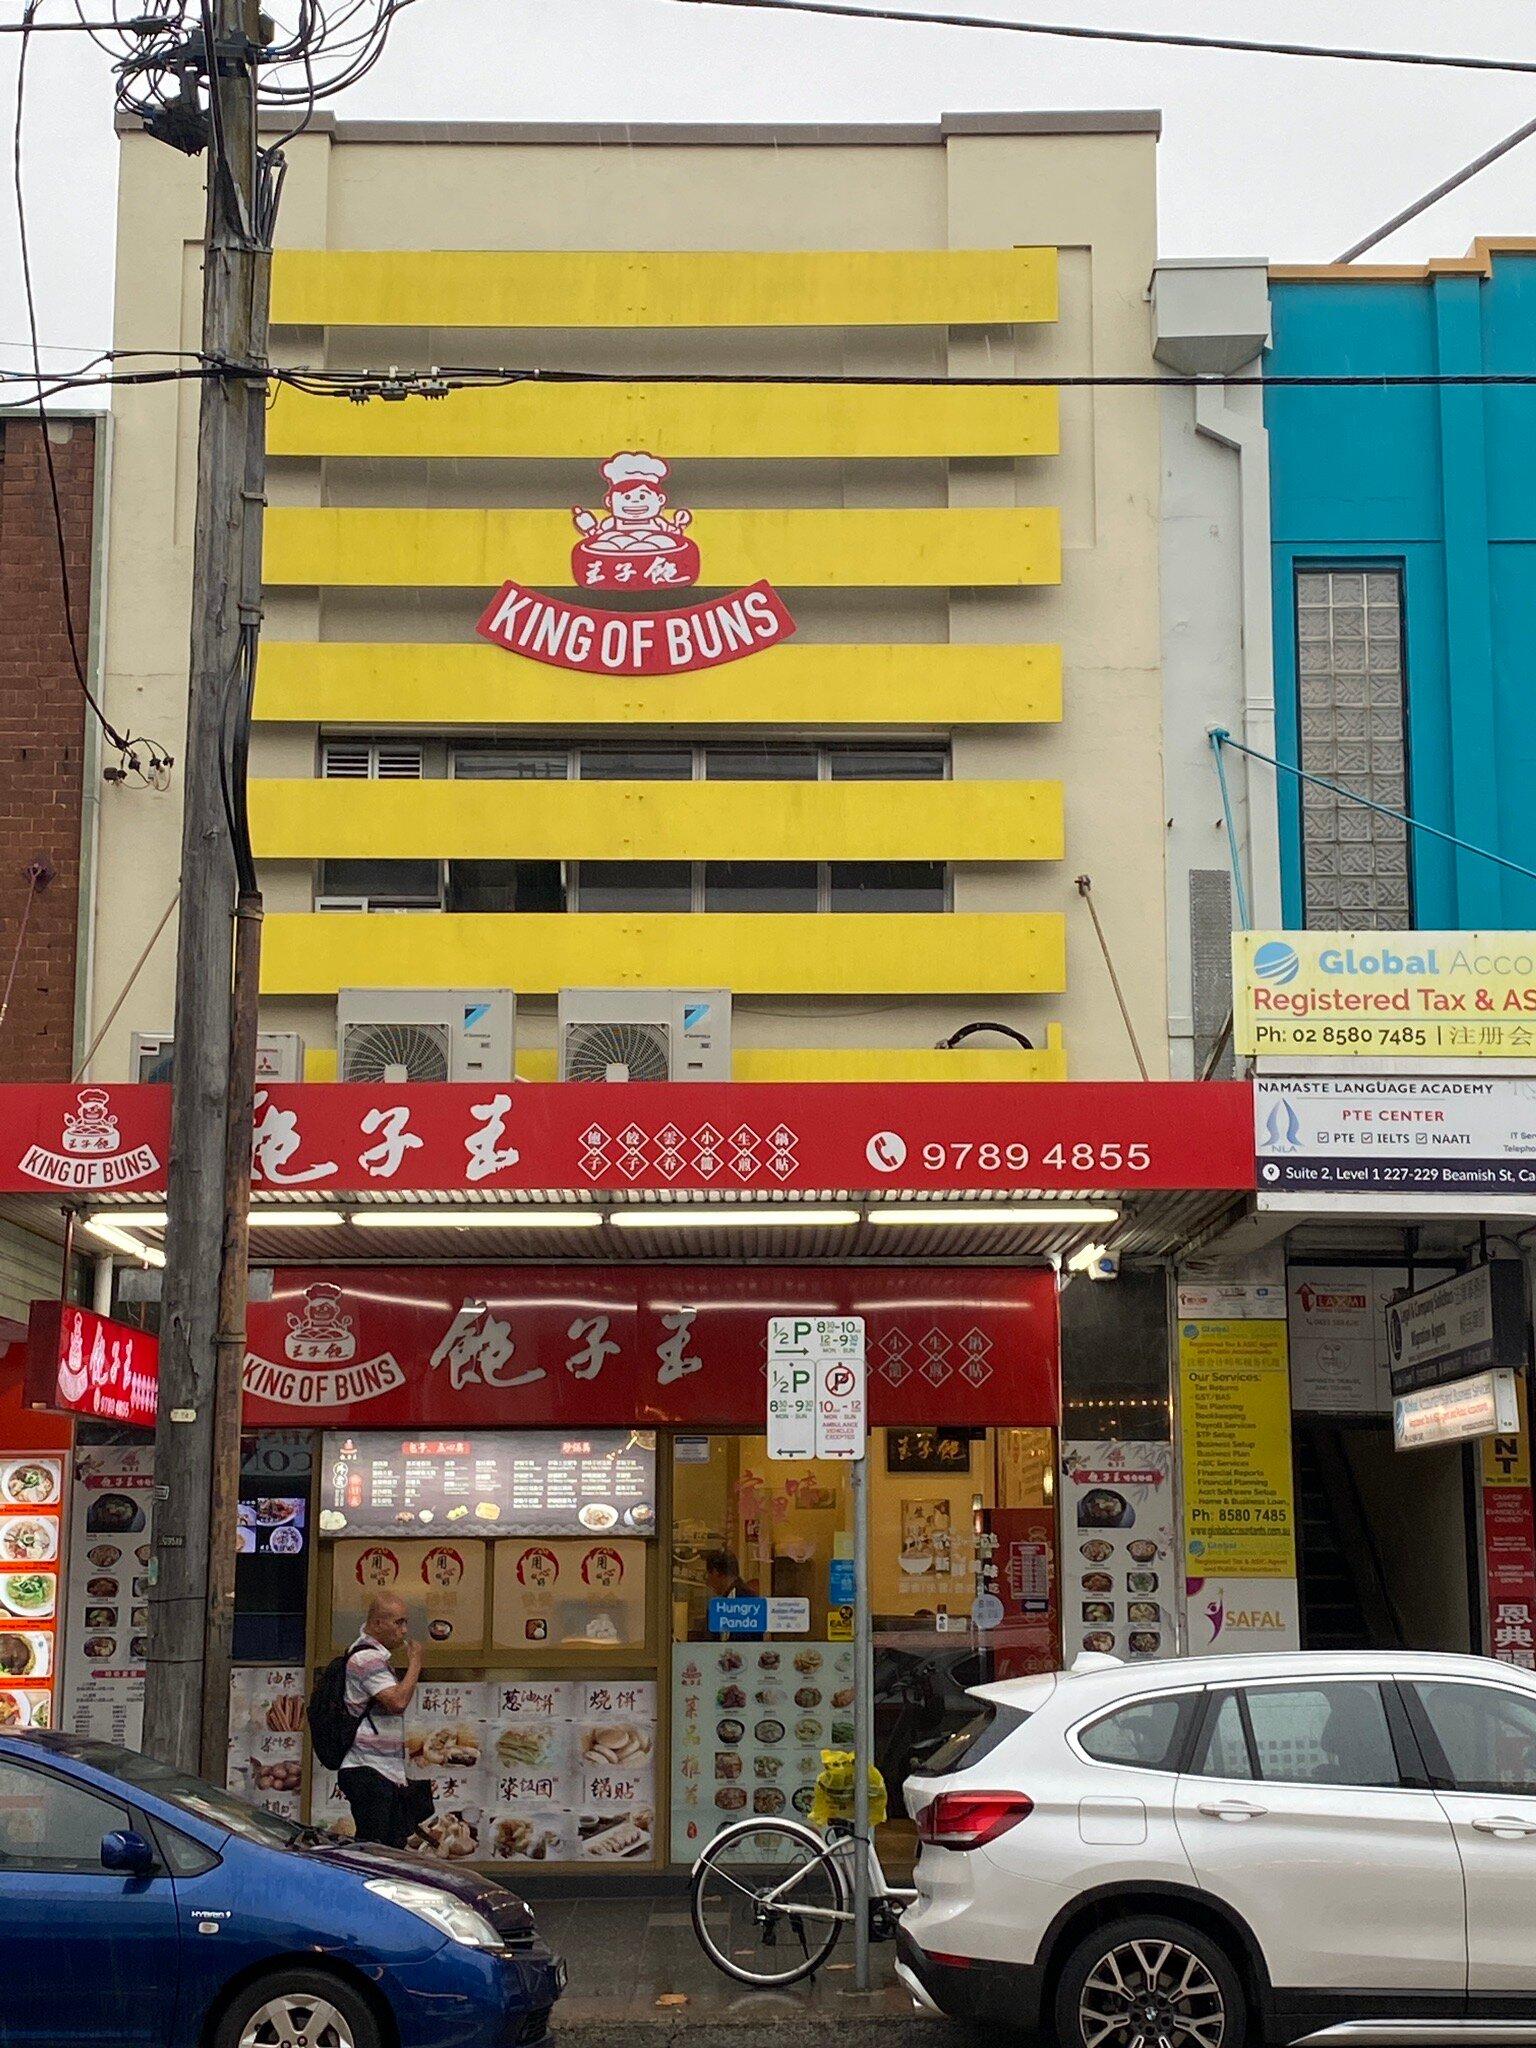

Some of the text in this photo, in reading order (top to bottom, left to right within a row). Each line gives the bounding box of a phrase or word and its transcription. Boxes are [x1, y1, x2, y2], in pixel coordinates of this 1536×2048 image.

[488, 588, 780, 668] KING OF BUNS
[1318, 948, 1440, 976] Global
[1253, 987, 1411, 1017] Registered
[1416, 987, 1467, 1012] Tax
[1474, 988, 1494, 1012] &
[1255, 1025, 1427, 1047] Ph: 02 8580 7485
[1258, 1081, 1495, 1095] NAMASTE LANGUAGE ACADEMY
[1342, 1109, 1445, 1123] PTE CENTER
[1333, 1132, 1472, 1145] PTE IELTS NAATI
[23, 1148, 155, 1186] KING OF BUNS
[922, 1141, 1152, 1172] 9789 4855
[1285, 1166, 1318, 1181] Suite
[1321, 1168, 1334, 1183] 2,
[1336, 1167, 1369, 1181] Level
[1373, 1168, 1380, 1181] 1
[1384, 1168, 1439, 1182] 227-229
[1443, 1167, 1497, 1182] Beamish
[1499, 1168, 1516, 1184] St,
[794, 1321, 812, 1345] P
[243, 1359, 397, 1402] KING OF BUNS
[793, 1370, 810, 1393] P
[1188, 1372, 1262, 1382] Our Services:
[1218, 1508, 1250, 1522] 8580
[1255, 1508, 1287, 1522] 7485
[716, 1601, 761, 1616] Hungry
[1225, 1610, 1286, 1628] SAFAL
[719, 1616, 758, 1629] Panda
[589, 1688, 638, 1711] 烧饼
[589, 1777, 636, 1800] 锅贴
